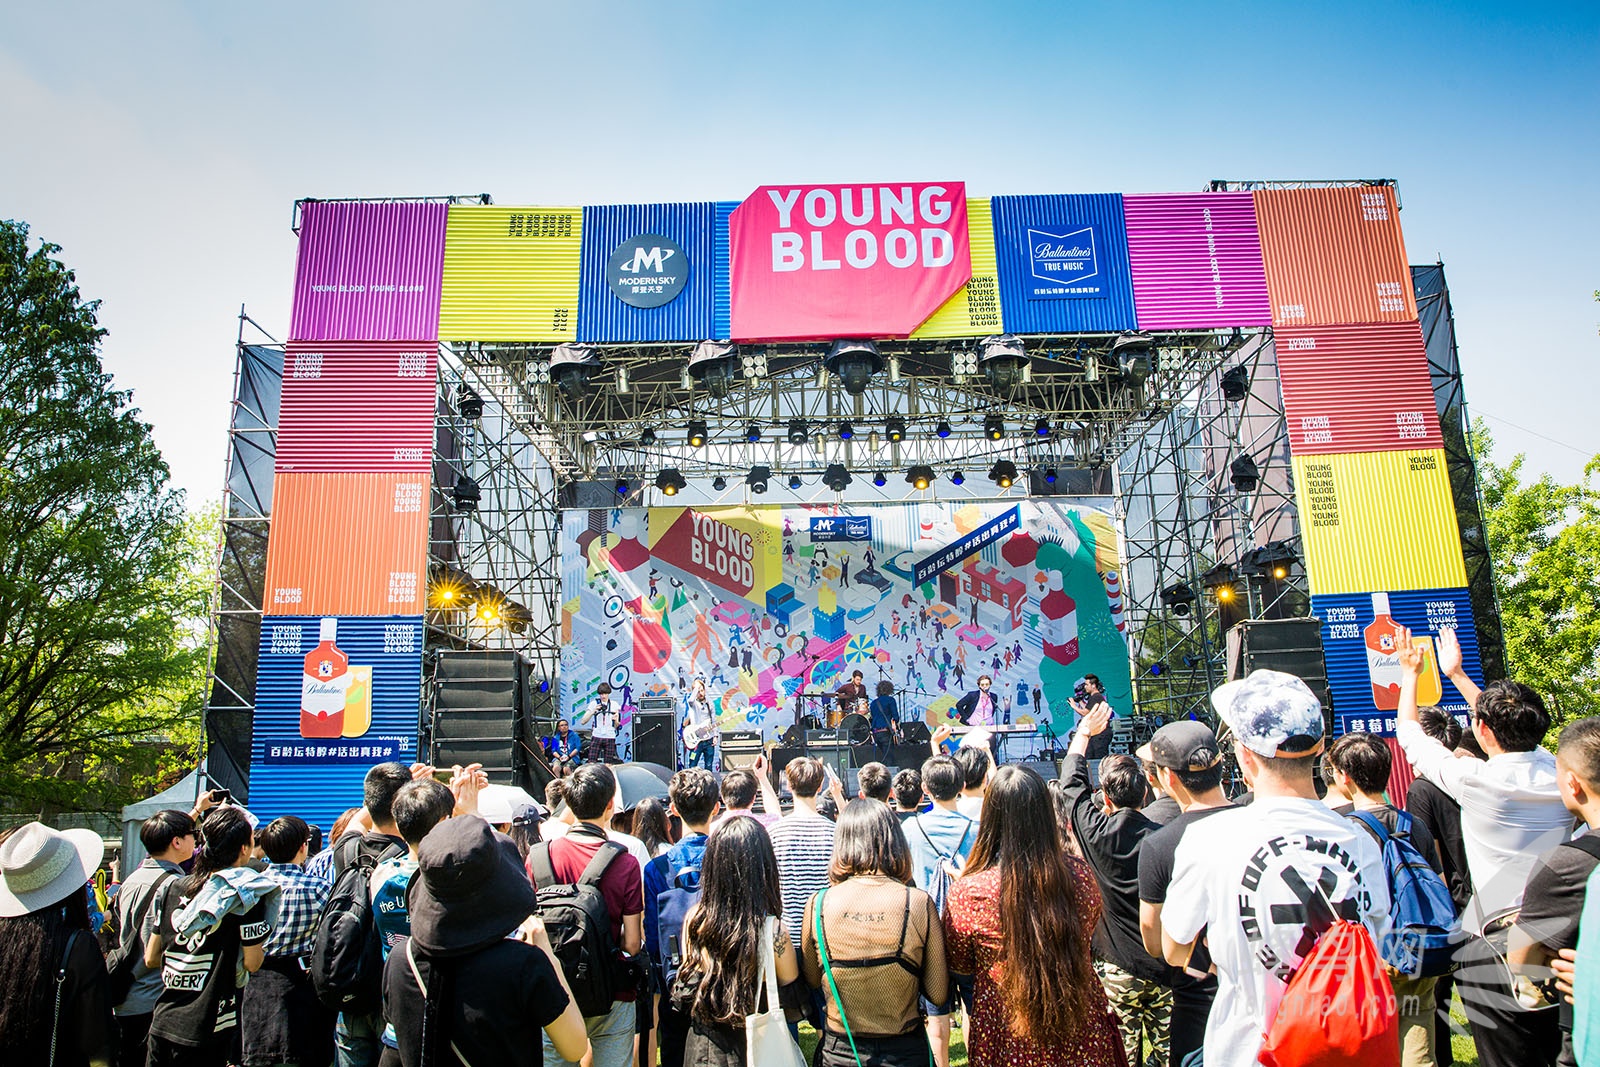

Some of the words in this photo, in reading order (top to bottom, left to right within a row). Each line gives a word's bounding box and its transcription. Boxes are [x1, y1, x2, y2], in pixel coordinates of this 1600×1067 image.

[767, 187, 952, 228] YOUNG
[771, 229, 954, 273] BLOOD
[1034, 243, 1091, 258] Ballantine's
[1044, 262, 1061, 271] TRUE
[1063, 262, 1084, 271] MUSIC
[690, 510, 753, 560] YOUNG
[692, 537, 753, 587] BLOOD
[390, 572, 416, 580] YOUNG
[274, 588, 302, 596] YOUNG
[274, 596, 302, 604] BLOOD
[1326, 607, 1356, 615] YOUNG
[1328, 614, 1356, 622] BLOOD
[1329, 624, 1358, 632] YOUNG
[380, 901, 395, 913] the
